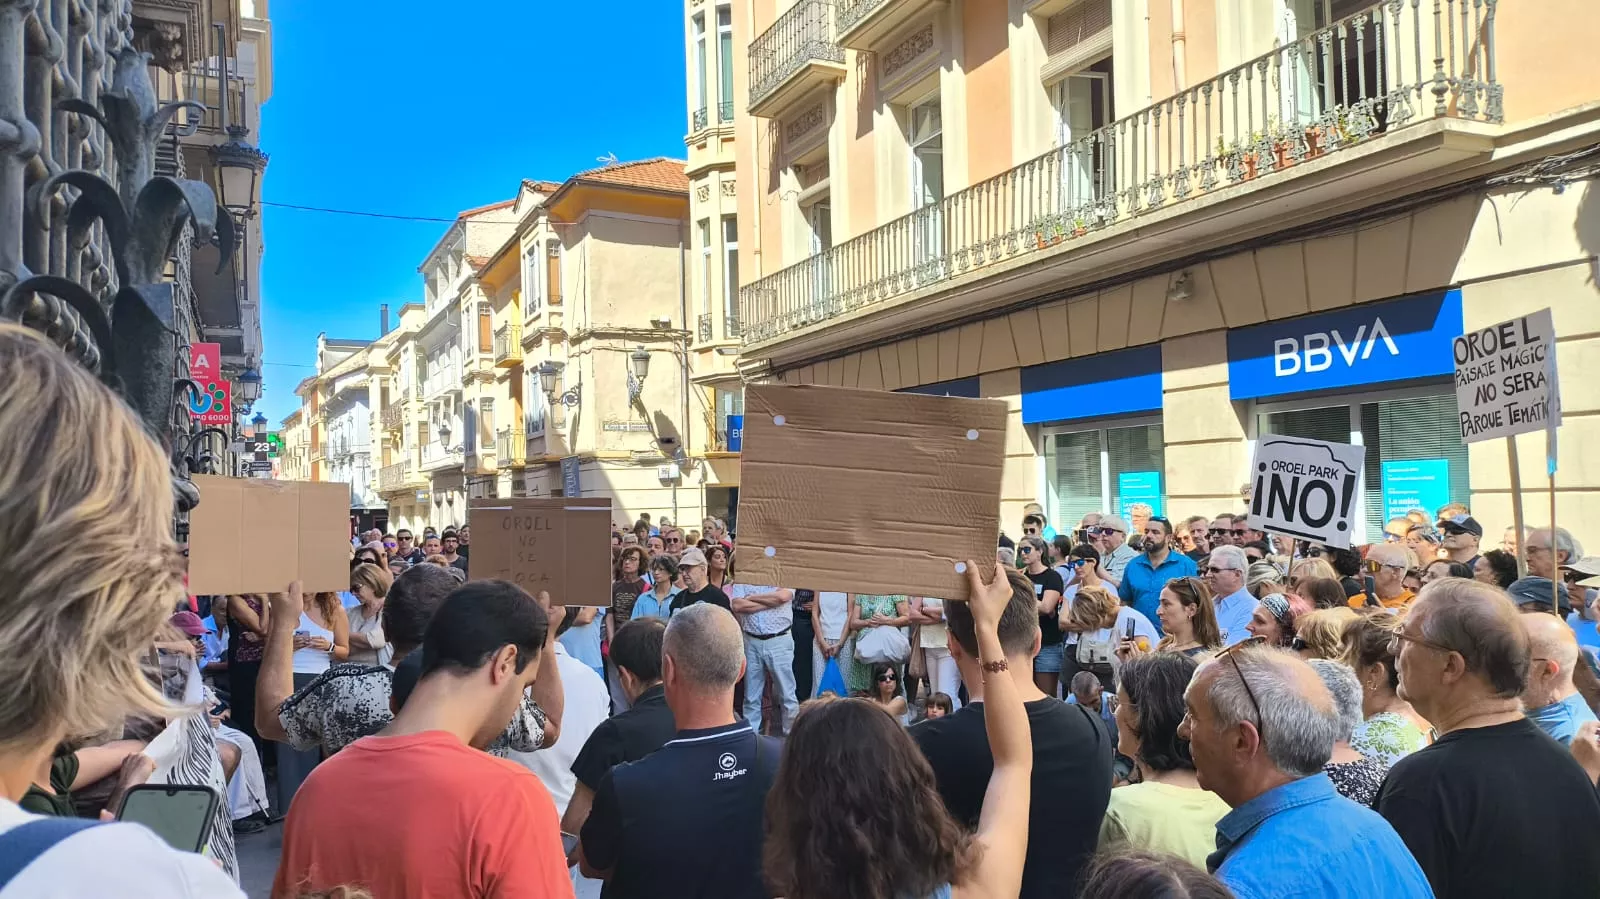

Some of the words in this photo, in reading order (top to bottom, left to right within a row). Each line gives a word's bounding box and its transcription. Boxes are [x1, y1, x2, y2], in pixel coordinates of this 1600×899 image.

[1274, 317, 1400, 377] BBVA
[1453, 317, 1541, 365] OROEL
[1474, 382, 1497, 407] NO
[1460, 410, 1504, 438] PARQUE
[1271, 460, 1307, 476] OROEL
[1308, 464, 1340, 480] PARK
[1252, 462, 1356, 532] ¡NO!
[502, 516, 553, 531] OROEL
[519, 535, 537, 547] NO
[517, 552, 537, 563] SE
